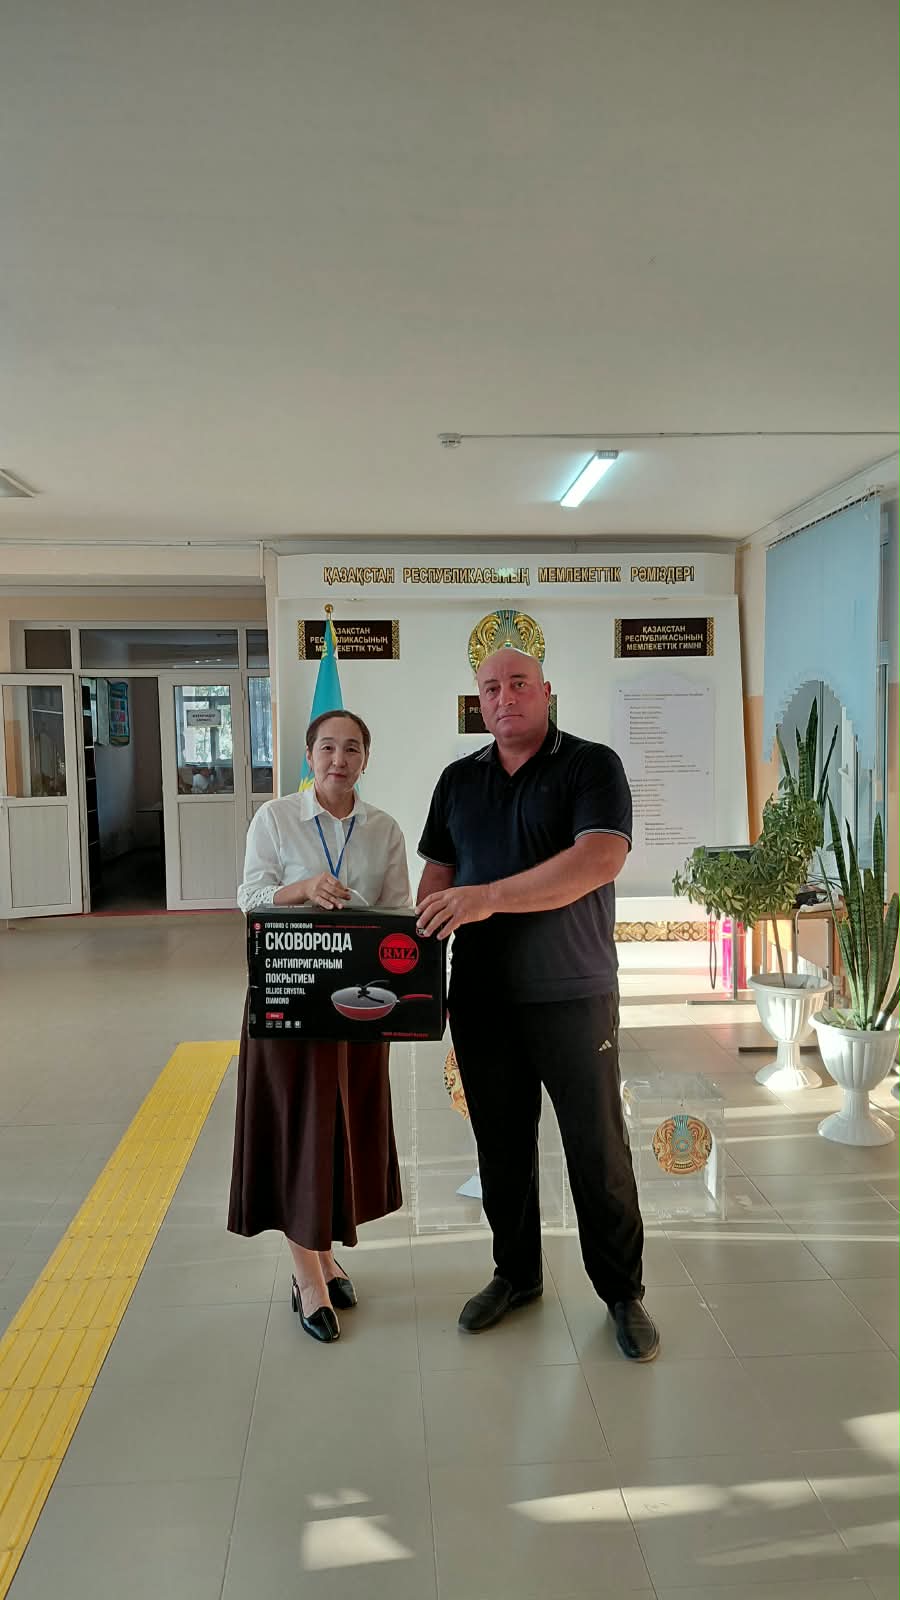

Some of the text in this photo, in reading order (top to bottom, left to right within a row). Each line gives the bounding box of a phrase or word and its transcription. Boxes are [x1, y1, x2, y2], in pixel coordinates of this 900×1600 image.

[323, 567, 395, 586] ҚАЗАҚСТАН
[538, 566, 622, 583] МЕМЛЕКЕТТІК
[630, 566, 695, 585] РӘМІЗДЕРІ
[642, 625, 686, 634] ҚАЗАҚСТАН
[310, 636, 388, 644] РЕСБЛИКАСЫНЫҢ
[625, 633, 704, 642] РЕСПУБЛИКАСЫНЫҢ
[626, 643, 677, 651] МЕМЛЕКЕТТІК
[265, 931, 353, 953] СКОВОРОДА
[382, 947, 416, 959] RMZ
[265, 958, 343, 969] С АНТИПРИГАРНЫМ
[265, 973, 315, 984] ПОКРЫТИЕМ
[283, 987, 306, 995] CRYSTAL
[265, 997, 290, 1005] DIAMOND
